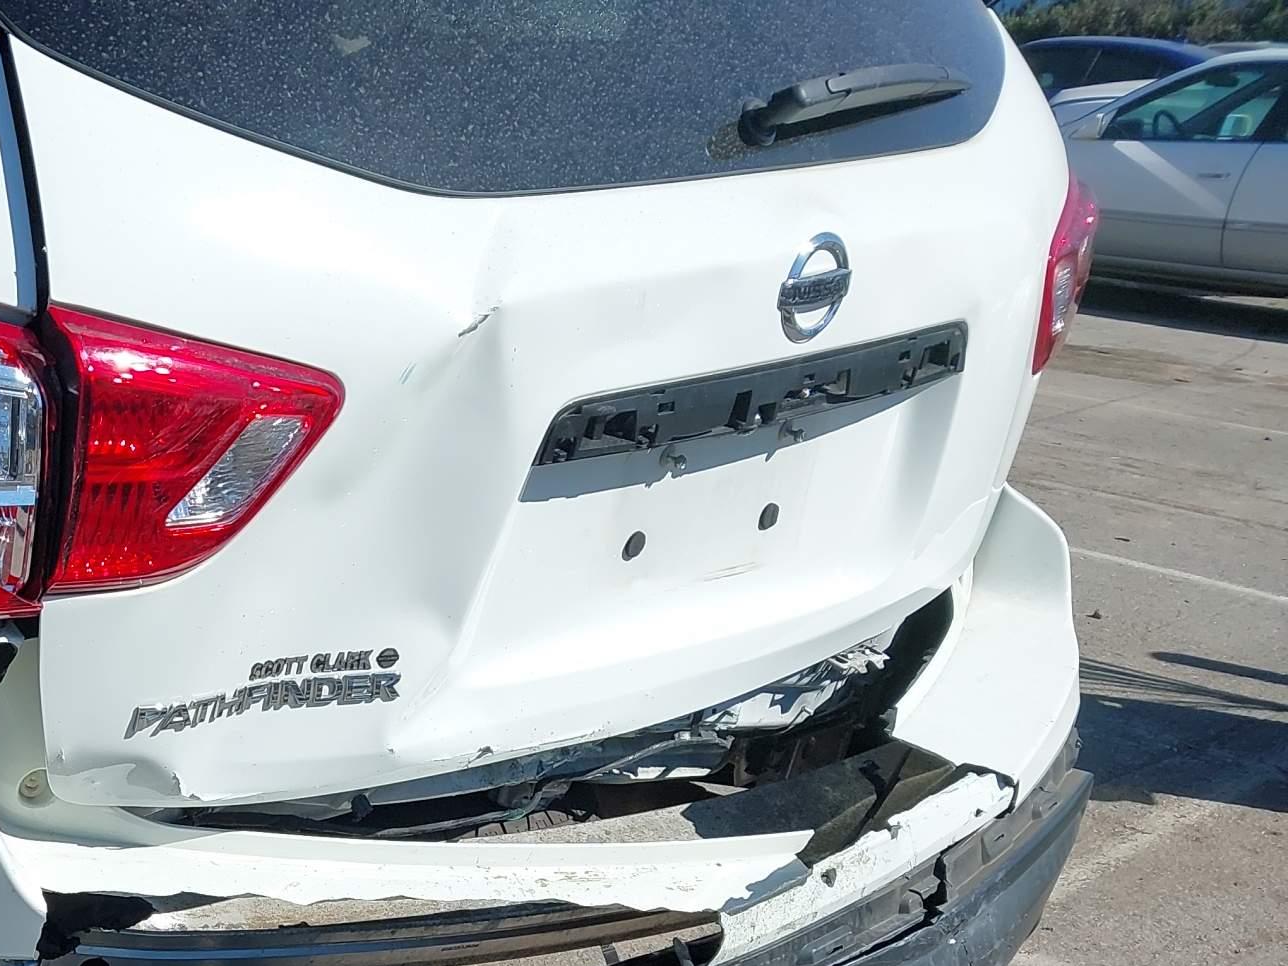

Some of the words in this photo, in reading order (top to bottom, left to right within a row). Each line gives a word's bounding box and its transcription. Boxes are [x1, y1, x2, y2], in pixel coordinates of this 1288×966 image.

[249, 655, 309, 681] SCOTT
[310, 650, 374, 673] CLARK
[123, 672, 402, 740] PATHFINDER
